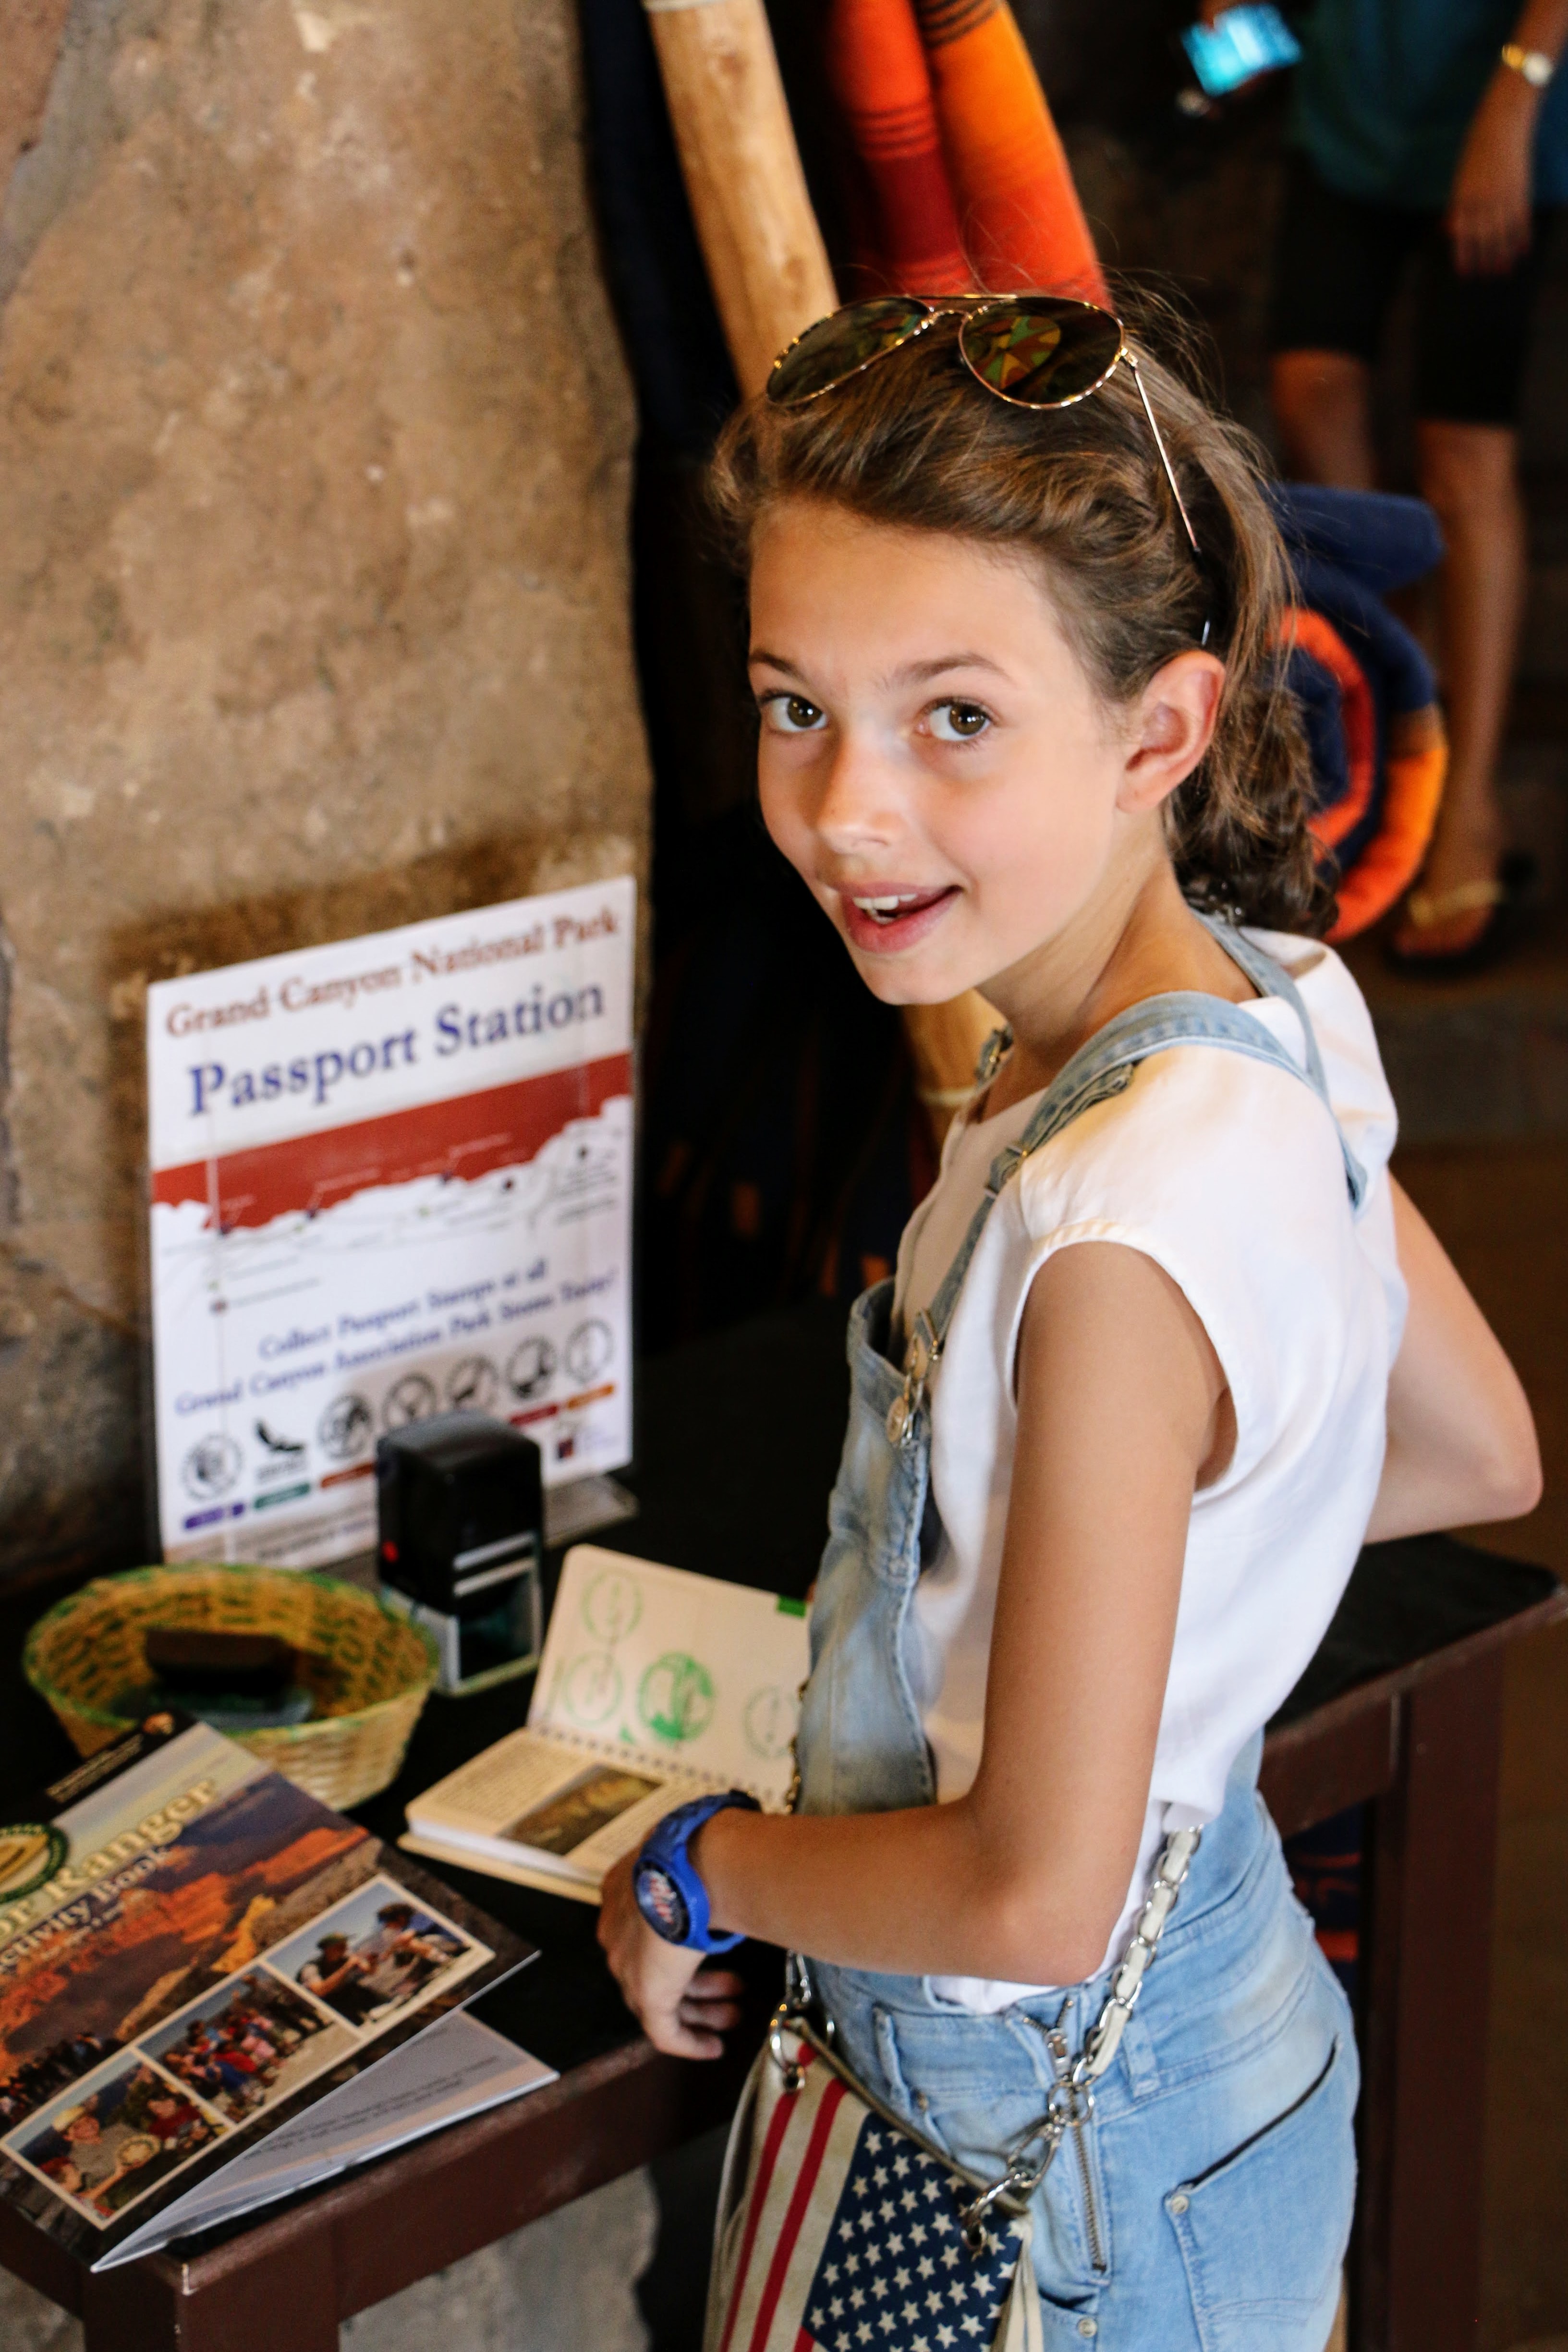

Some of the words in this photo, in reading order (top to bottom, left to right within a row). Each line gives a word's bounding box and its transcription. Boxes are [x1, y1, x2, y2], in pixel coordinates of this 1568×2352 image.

[166, 982, 271, 1037] Grand
[279, 964, 402, 1011] Canyon
[411, 920, 544, 984] National
[553, 905, 618, 949] Park
[189, 1028, 416, 1117] Passport
[435, 981, 605, 1056] Station
[44, 1779, 216, 1902] Ranger
[0, 1898, 92, 1968] ctivity
[90, 1846, 169, 1904] Book
